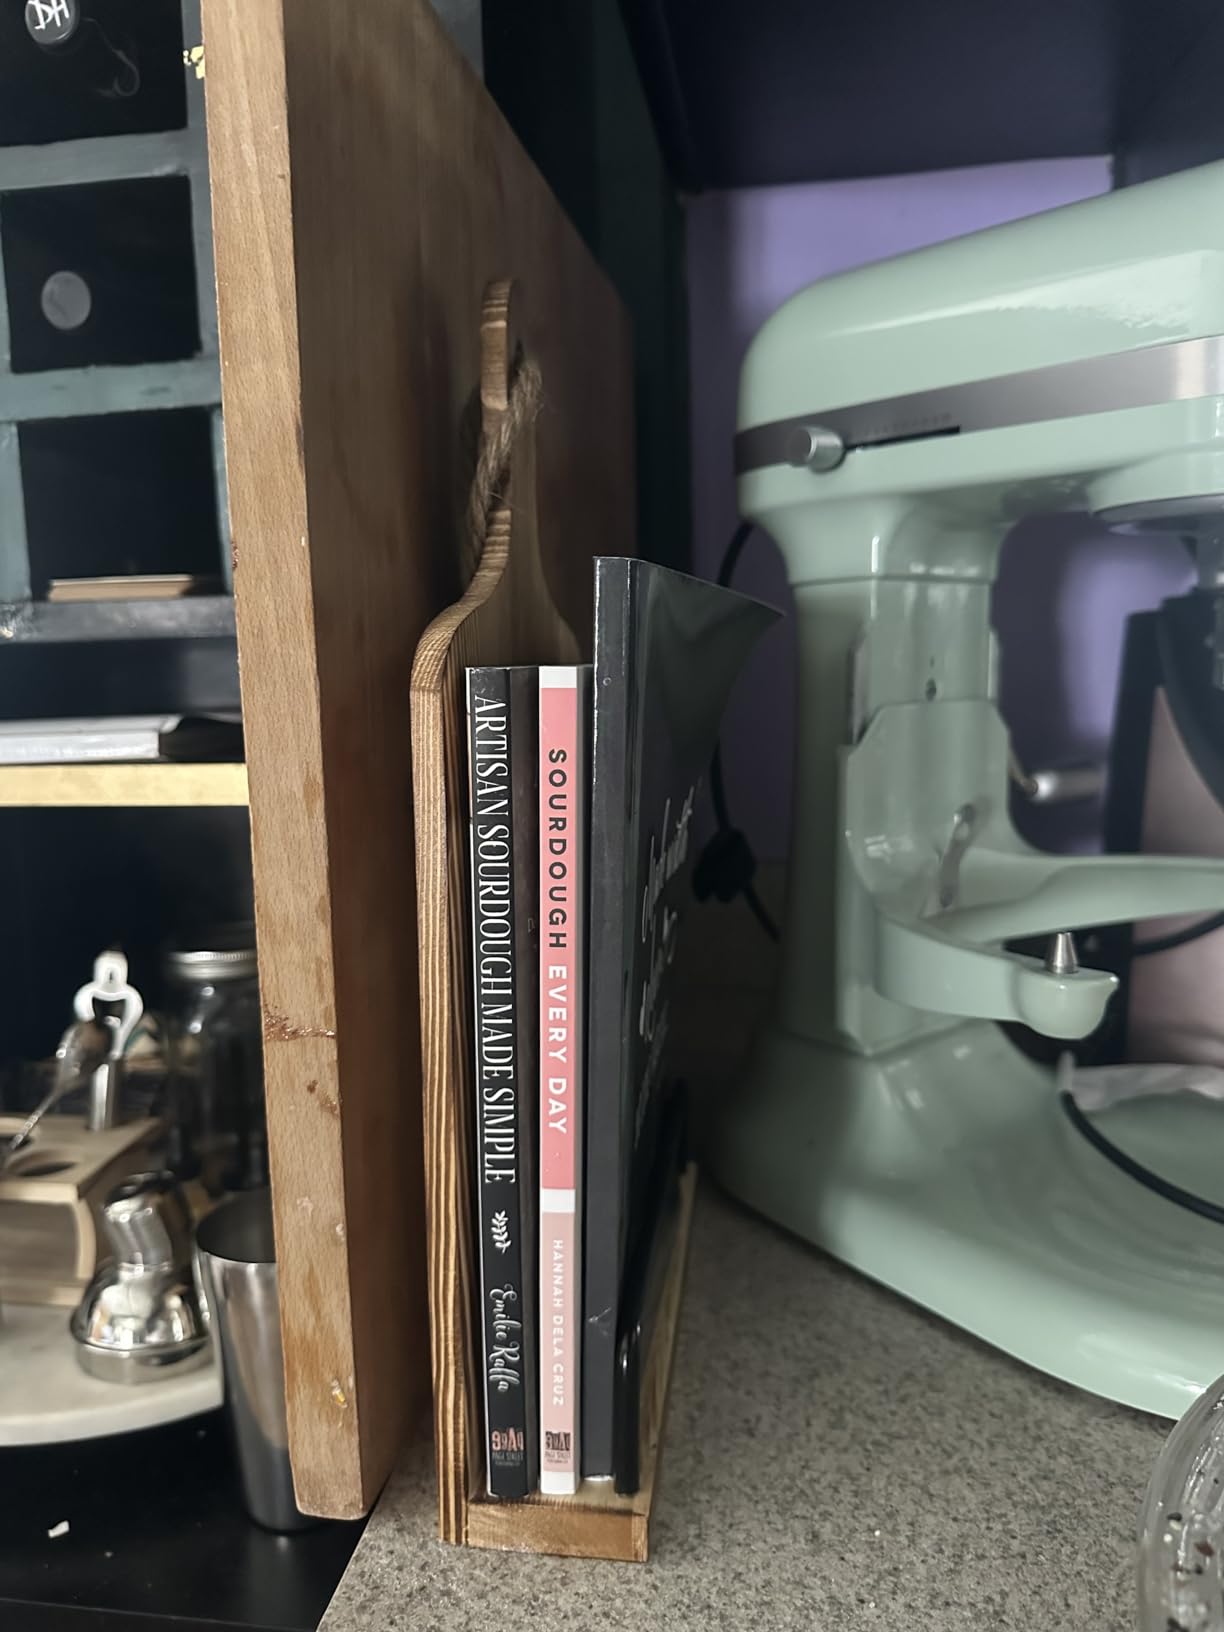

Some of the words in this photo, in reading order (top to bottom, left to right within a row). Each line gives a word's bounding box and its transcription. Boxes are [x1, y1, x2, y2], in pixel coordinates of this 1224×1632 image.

[474, 695, 508, 816] ARTISAN
[548, 749, 567, 948] SOURDOUGH
[477, 824, 512, 995] SOURDOUGH
[481, 1003, 514, 1080] MADE
[548, 965, 567, 1063] EVERY
[483, 1088, 516, 1183] SIMPLE
[548, 1078, 567, 1134] DAY
[552, 1239, 565, 1308] HANNAH
[489, 1284, 522, 1340] Emilie
[552, 1315, 565, 1357] DELA
[488, 1341, 520, 1391] Raffa
[552, 1365, 565, 1406] CRUZ
